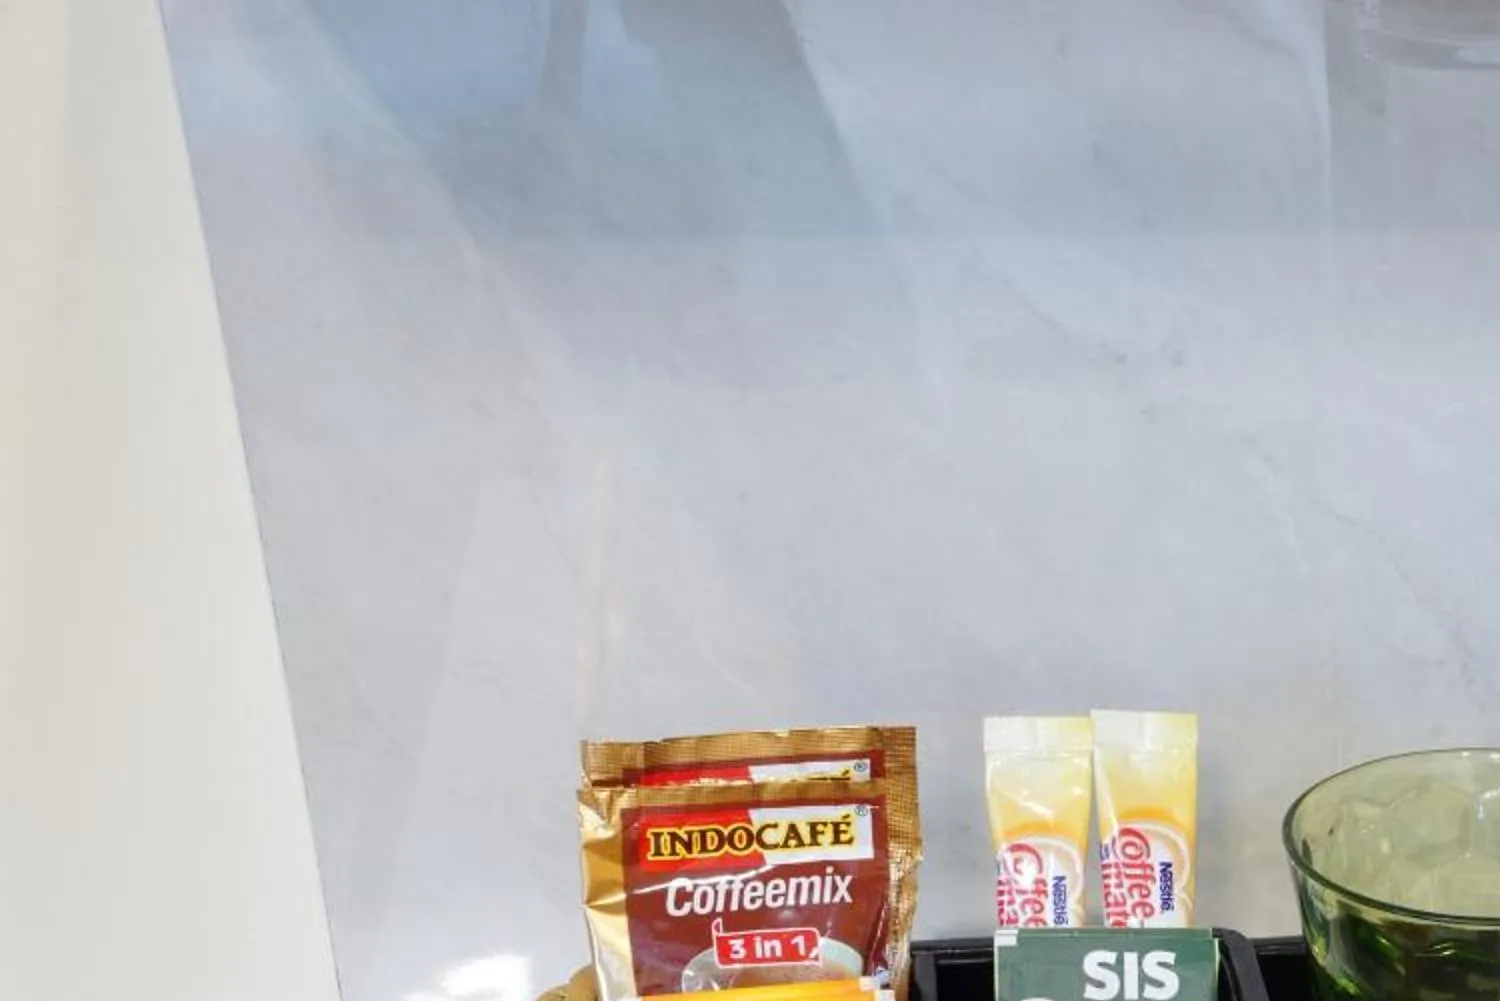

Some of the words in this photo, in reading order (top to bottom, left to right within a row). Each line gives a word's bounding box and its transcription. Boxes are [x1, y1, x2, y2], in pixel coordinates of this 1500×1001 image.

[648, 814, 855, 860] INDOCAFÉ
[665, 866, 853, 917] Coffeemix
[727, 938, 747, 961] 3
[755, 936, 782, 960] in
[792, 937, 808, 959] 1
[1083, 949, 1180, 1001] SIS
